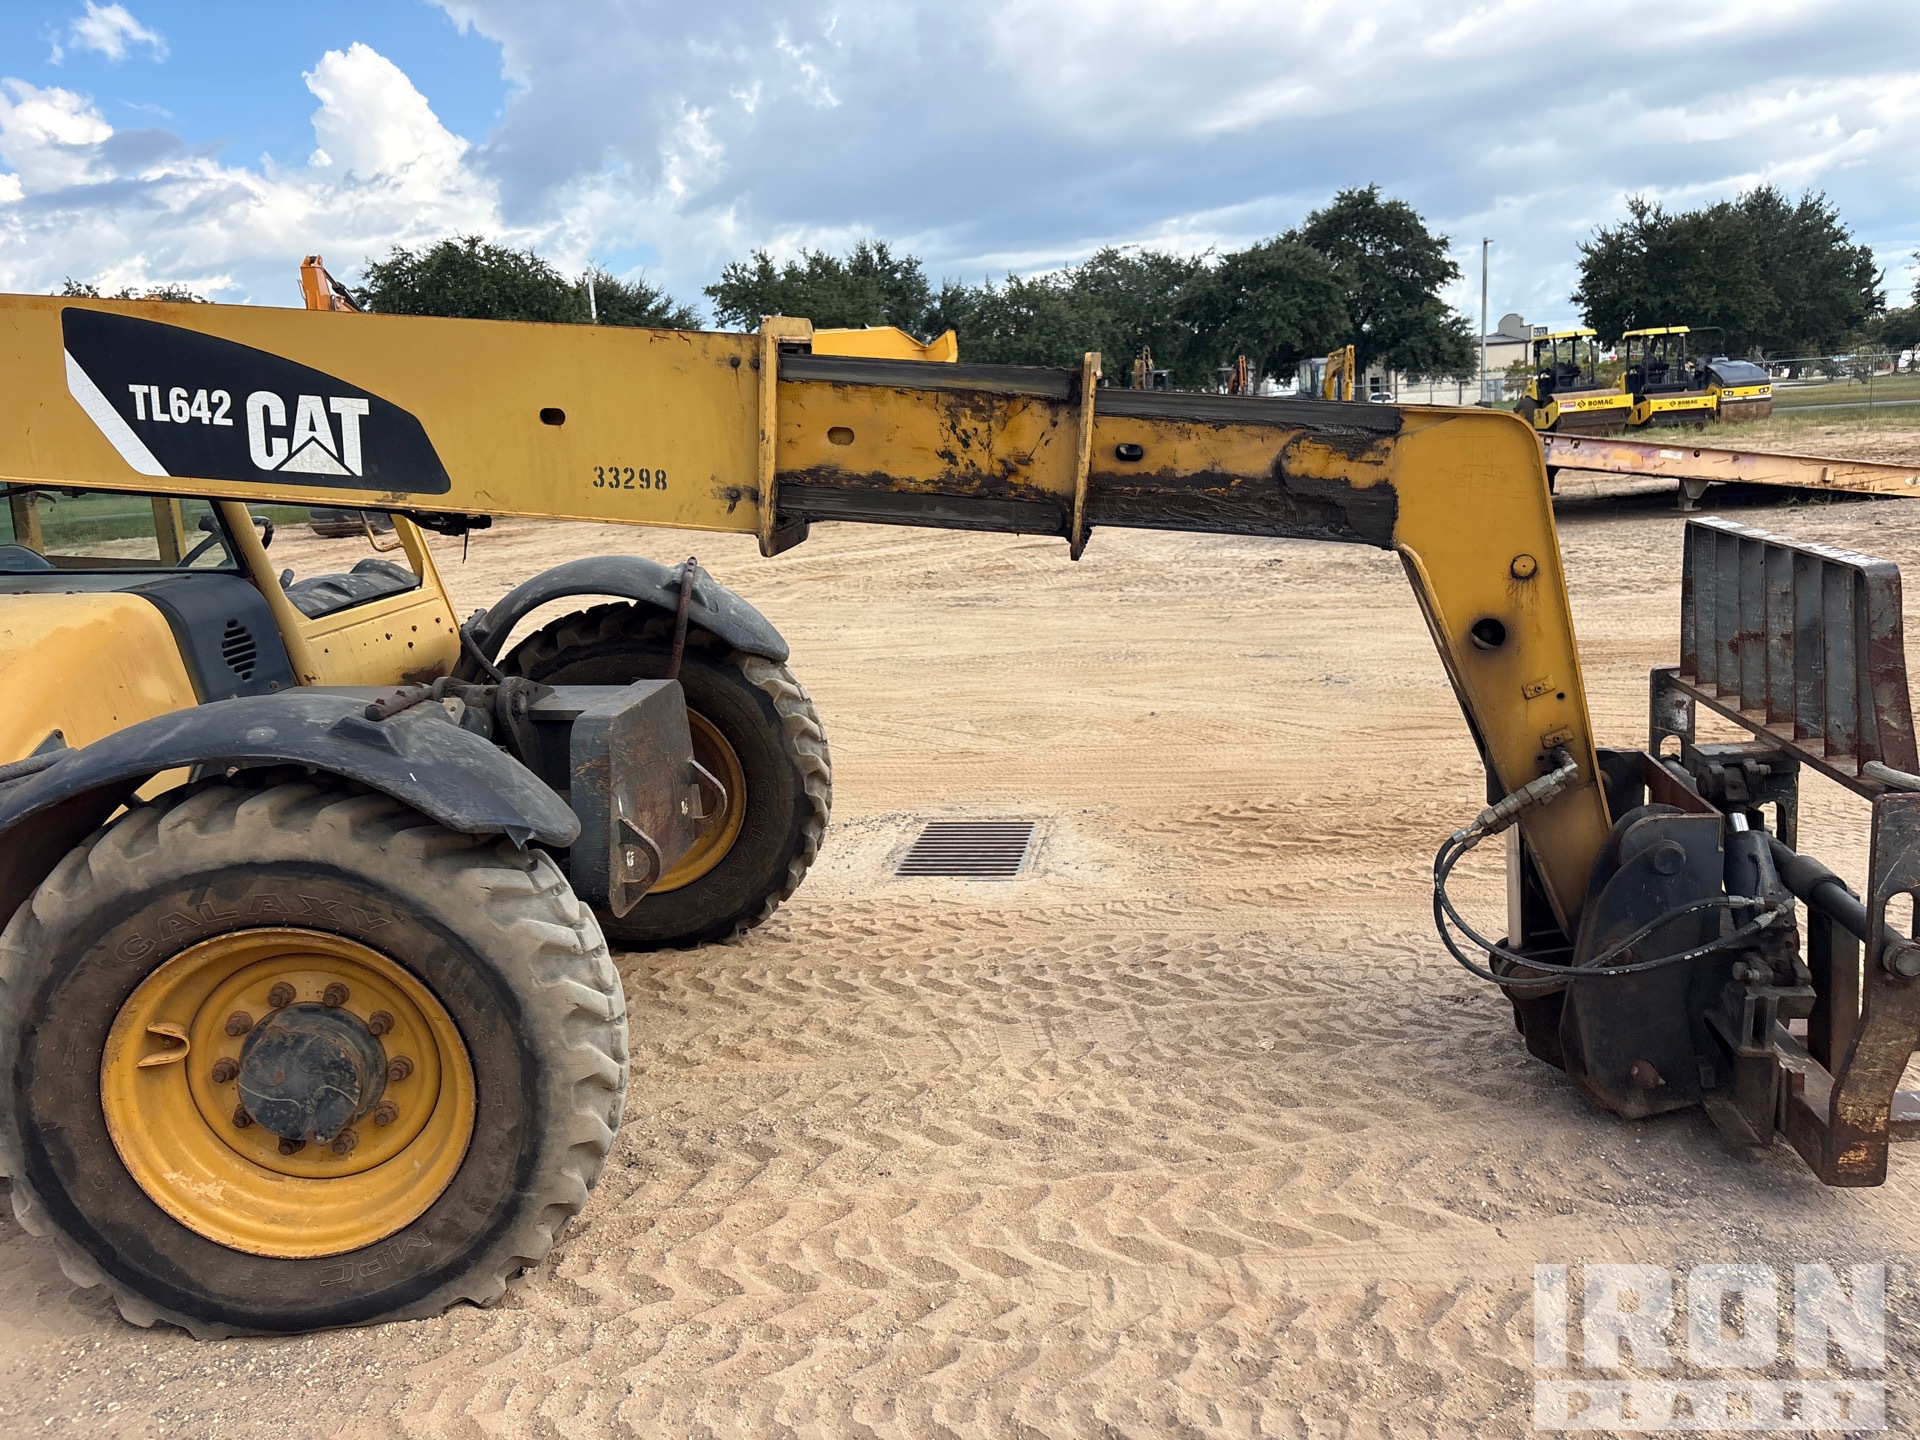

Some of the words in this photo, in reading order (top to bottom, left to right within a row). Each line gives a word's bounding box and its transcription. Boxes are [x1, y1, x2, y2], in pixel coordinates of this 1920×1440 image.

[128, 384, 234, 426] TL642
[246, 390, 370, 477] CAT
[592, 465, 668, 491] 33298
[697, 779, 771, 908] GALAXY
[114, 893, 392, 962] GALAXY
[319, 1233, 432, 1287] MPC
